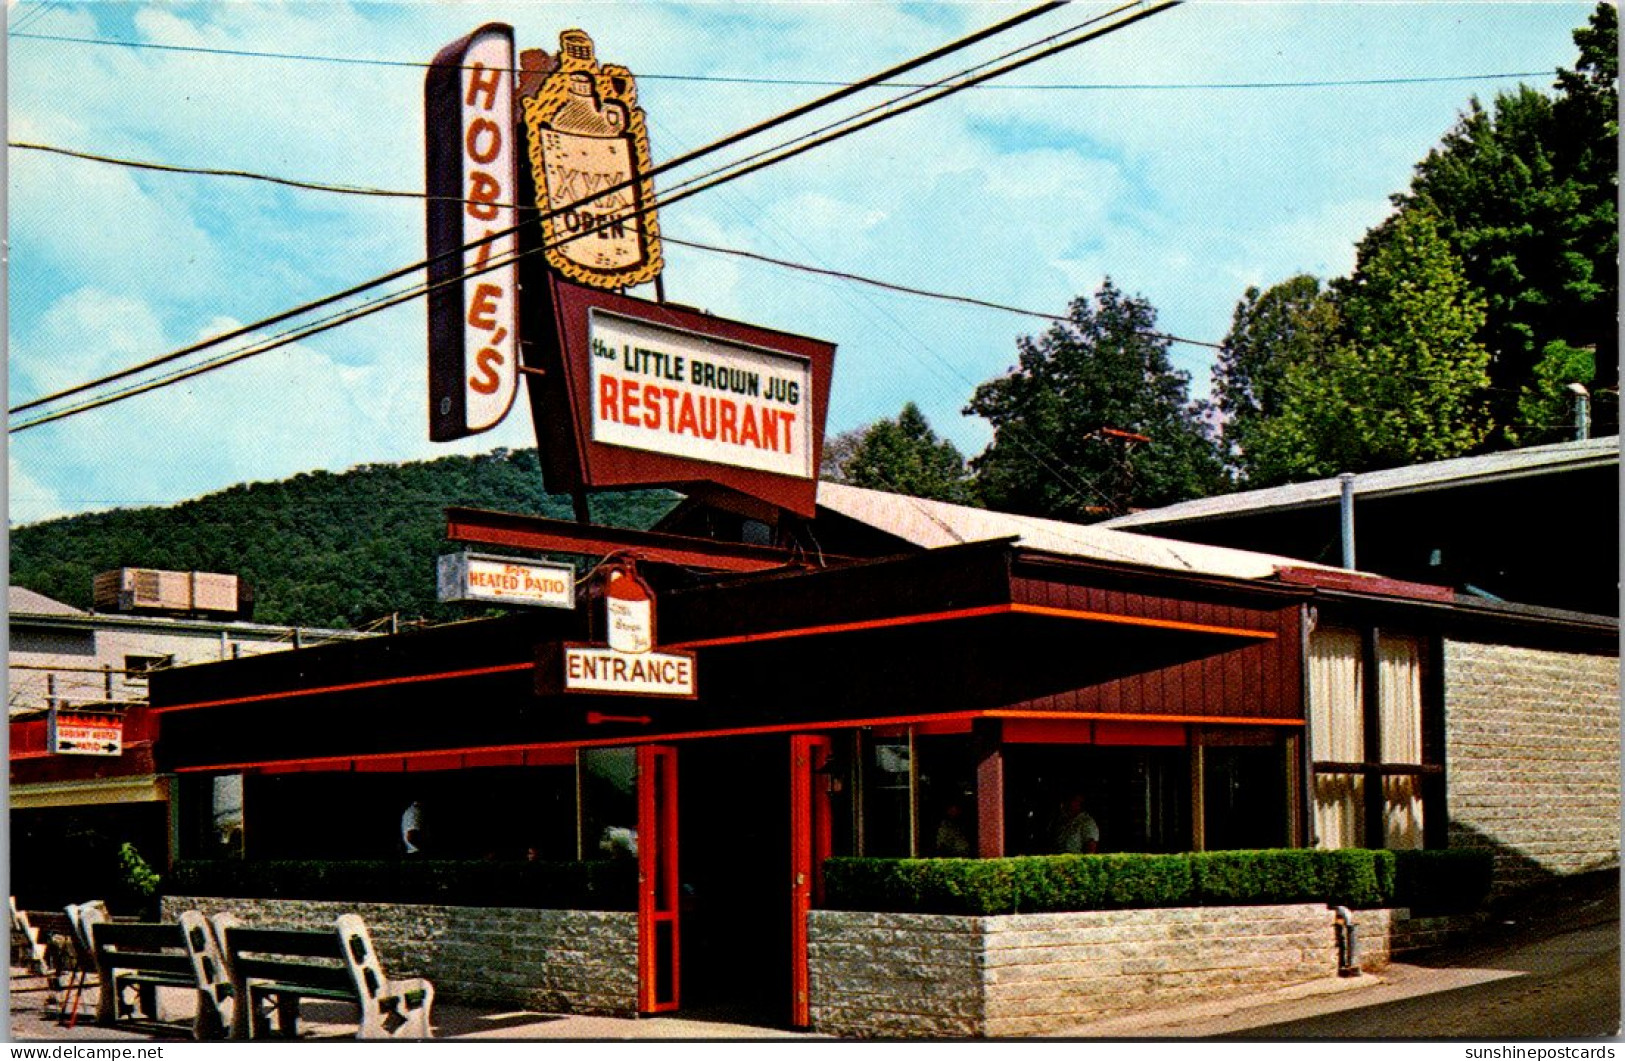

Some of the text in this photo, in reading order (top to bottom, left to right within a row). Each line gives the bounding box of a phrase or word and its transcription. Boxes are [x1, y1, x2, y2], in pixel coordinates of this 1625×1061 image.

[466, 61, 507, 395] HOBIE'S
[564, 211, 624, 239] OPEN
[592, 338, 799, 405] the LITTLE BROWN JUG
[600, 373, 796, 454] RESTAURANT
[469, 572, 565, 593] HEATED PATIO
[568, 654, 689, 685] ENTRANCE
